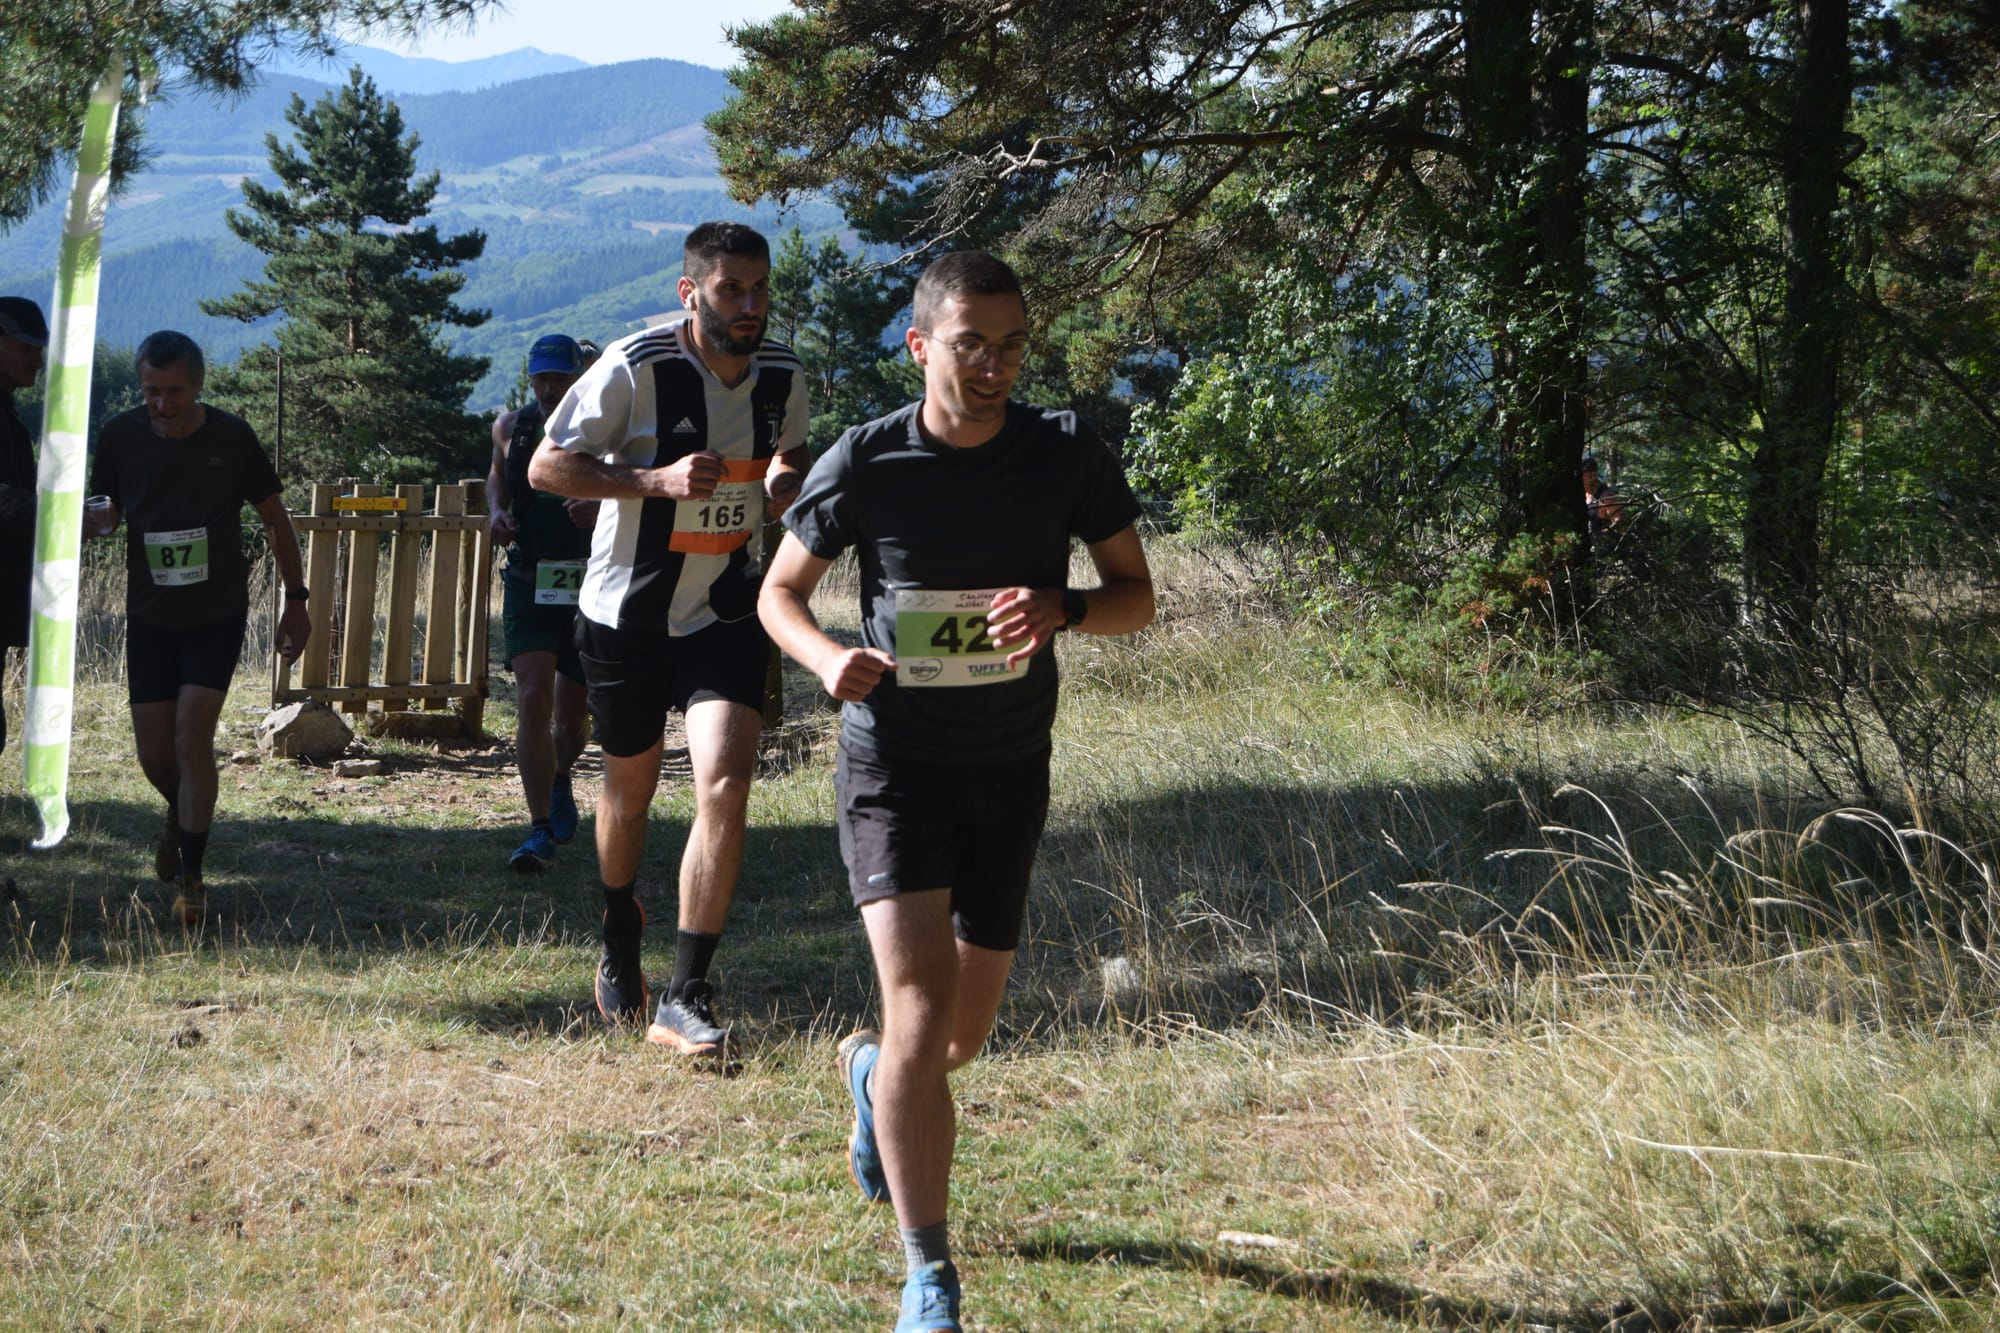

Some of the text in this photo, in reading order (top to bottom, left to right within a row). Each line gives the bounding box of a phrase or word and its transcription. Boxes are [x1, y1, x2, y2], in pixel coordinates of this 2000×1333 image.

[699, 504, 745, 528] 165
[161, 545, 193, 567] 87
[552, 569, 581, 589] 21
[932, 617, 994, 653] 42
